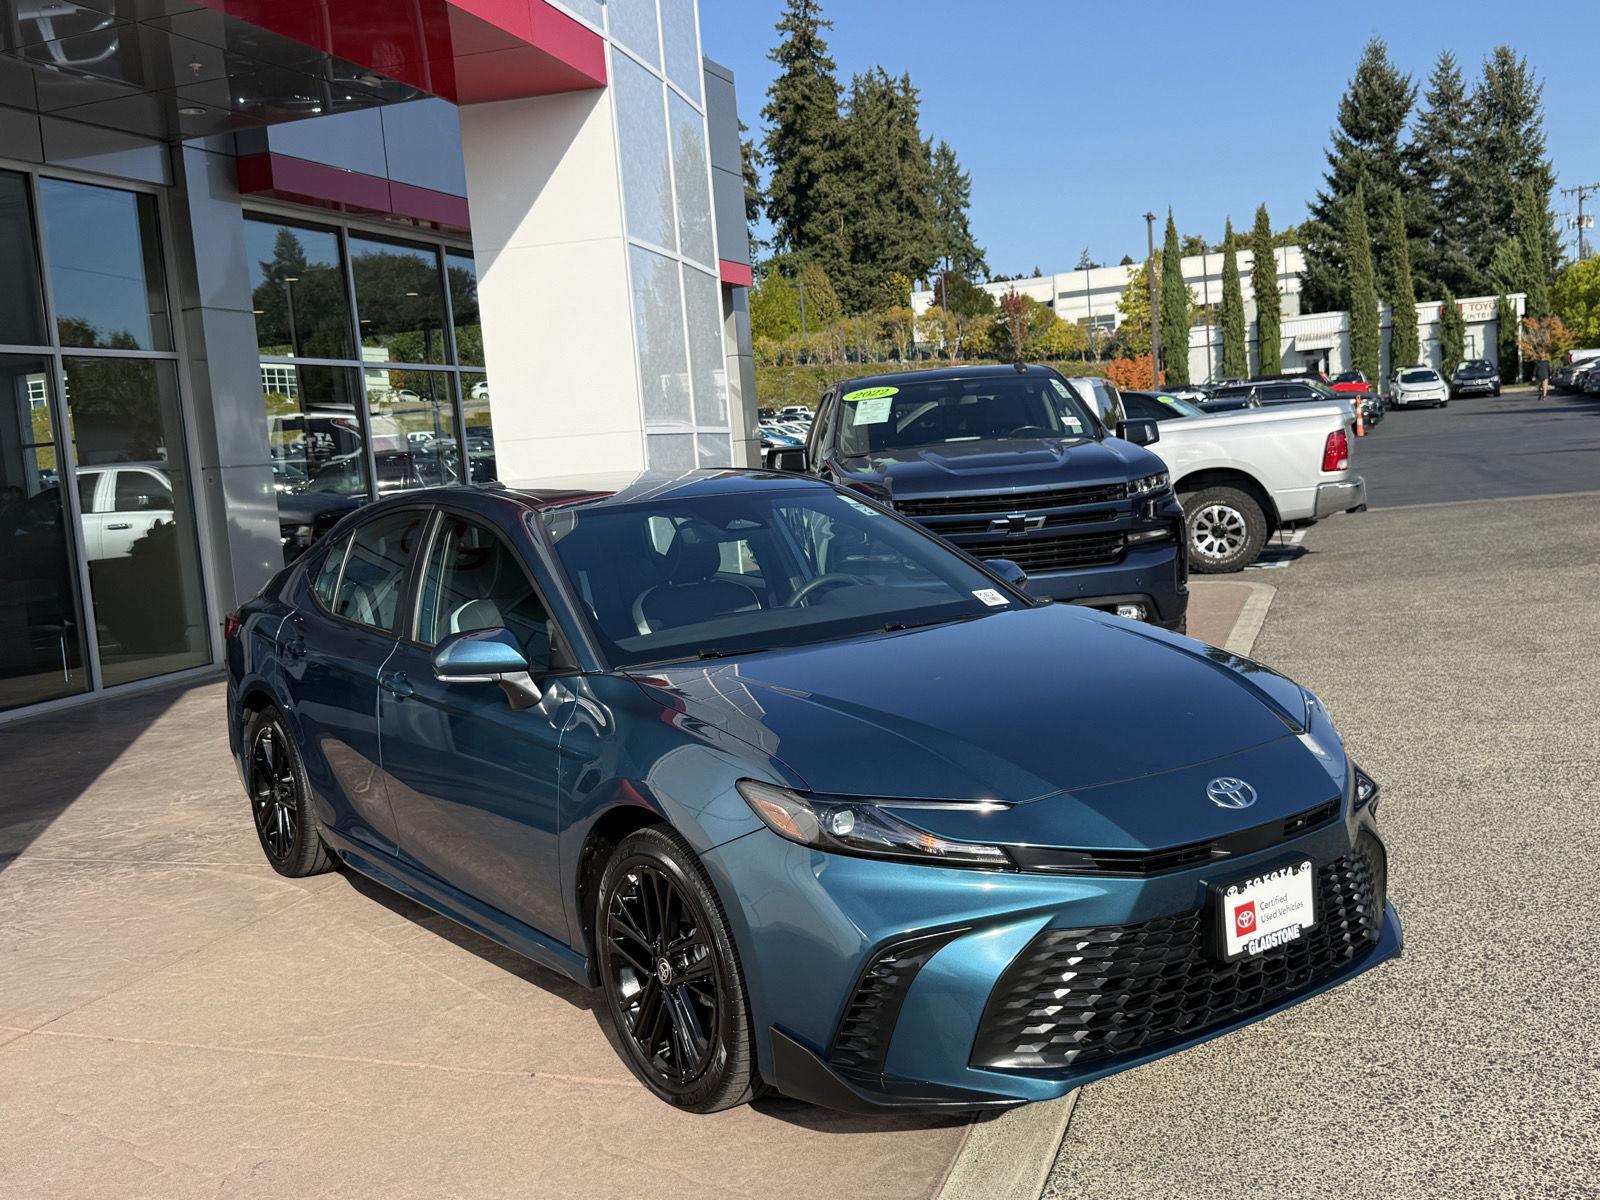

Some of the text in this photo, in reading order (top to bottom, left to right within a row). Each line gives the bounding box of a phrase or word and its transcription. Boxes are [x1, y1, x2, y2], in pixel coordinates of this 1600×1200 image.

[1470, 302, 1497, 311] TOYO
[853, 389, 890, 399] 2022
[1259, 892, 1288, 911] Certified
[1260, 900, 1304, 924] Used Vehicles
[1247, 922, 1301, 956] GLADSTONE
